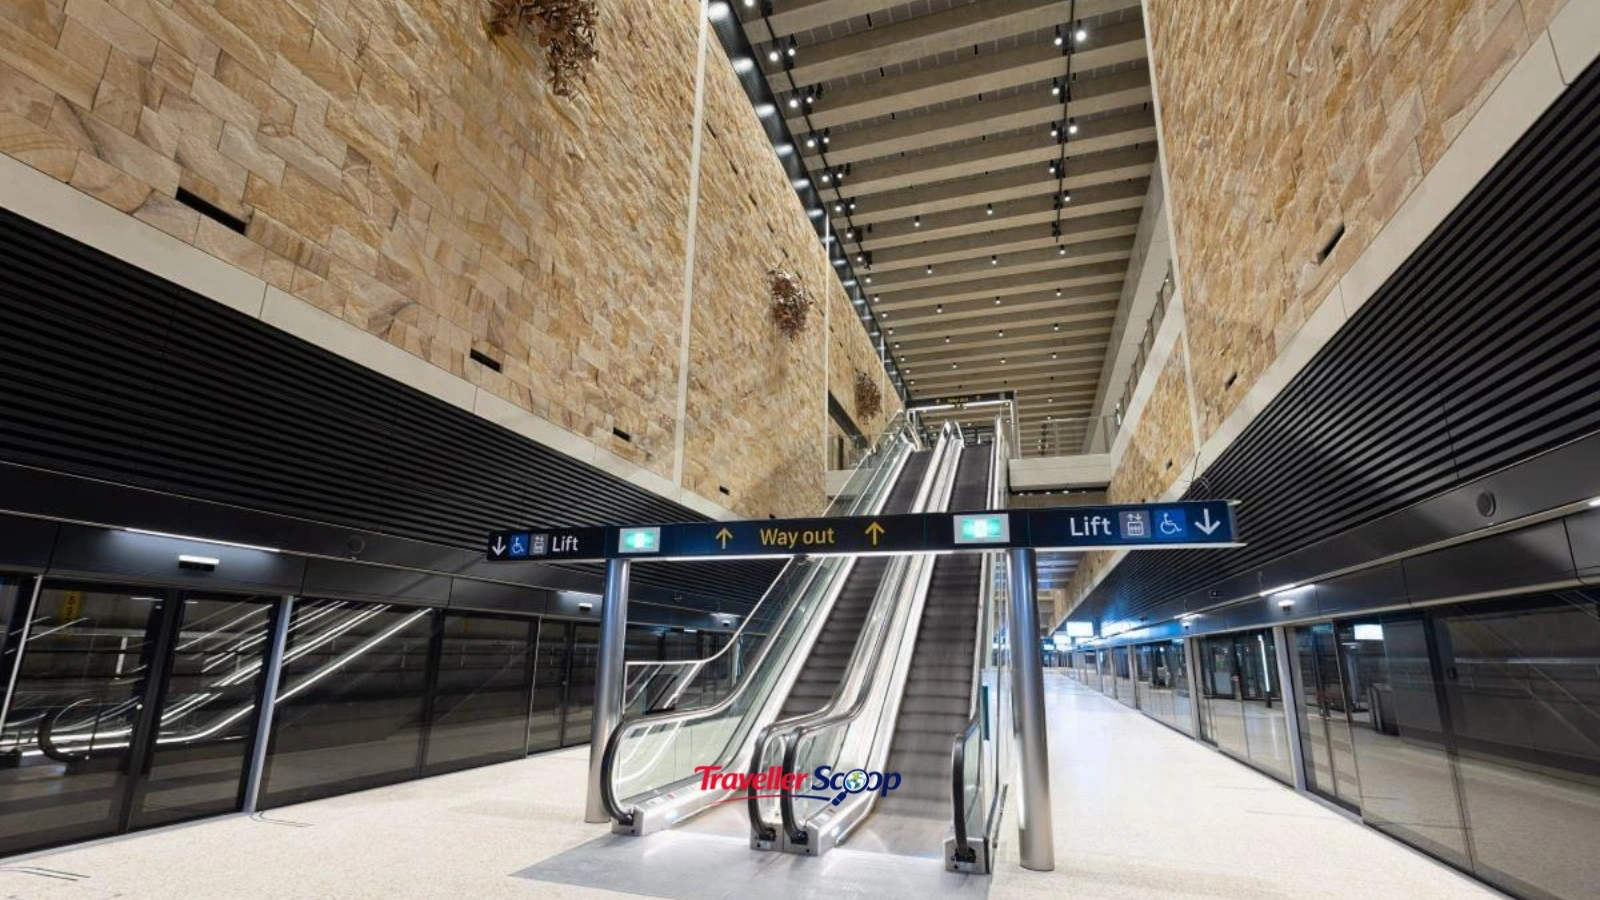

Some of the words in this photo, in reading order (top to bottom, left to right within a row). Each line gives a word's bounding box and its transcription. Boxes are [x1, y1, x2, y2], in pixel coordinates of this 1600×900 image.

[1070, 516, 1112, 537] Lift
[552, 535, 579, 552] Lift
[760, 528, 798, 549] Way
[803, 527, 834, 545] out
